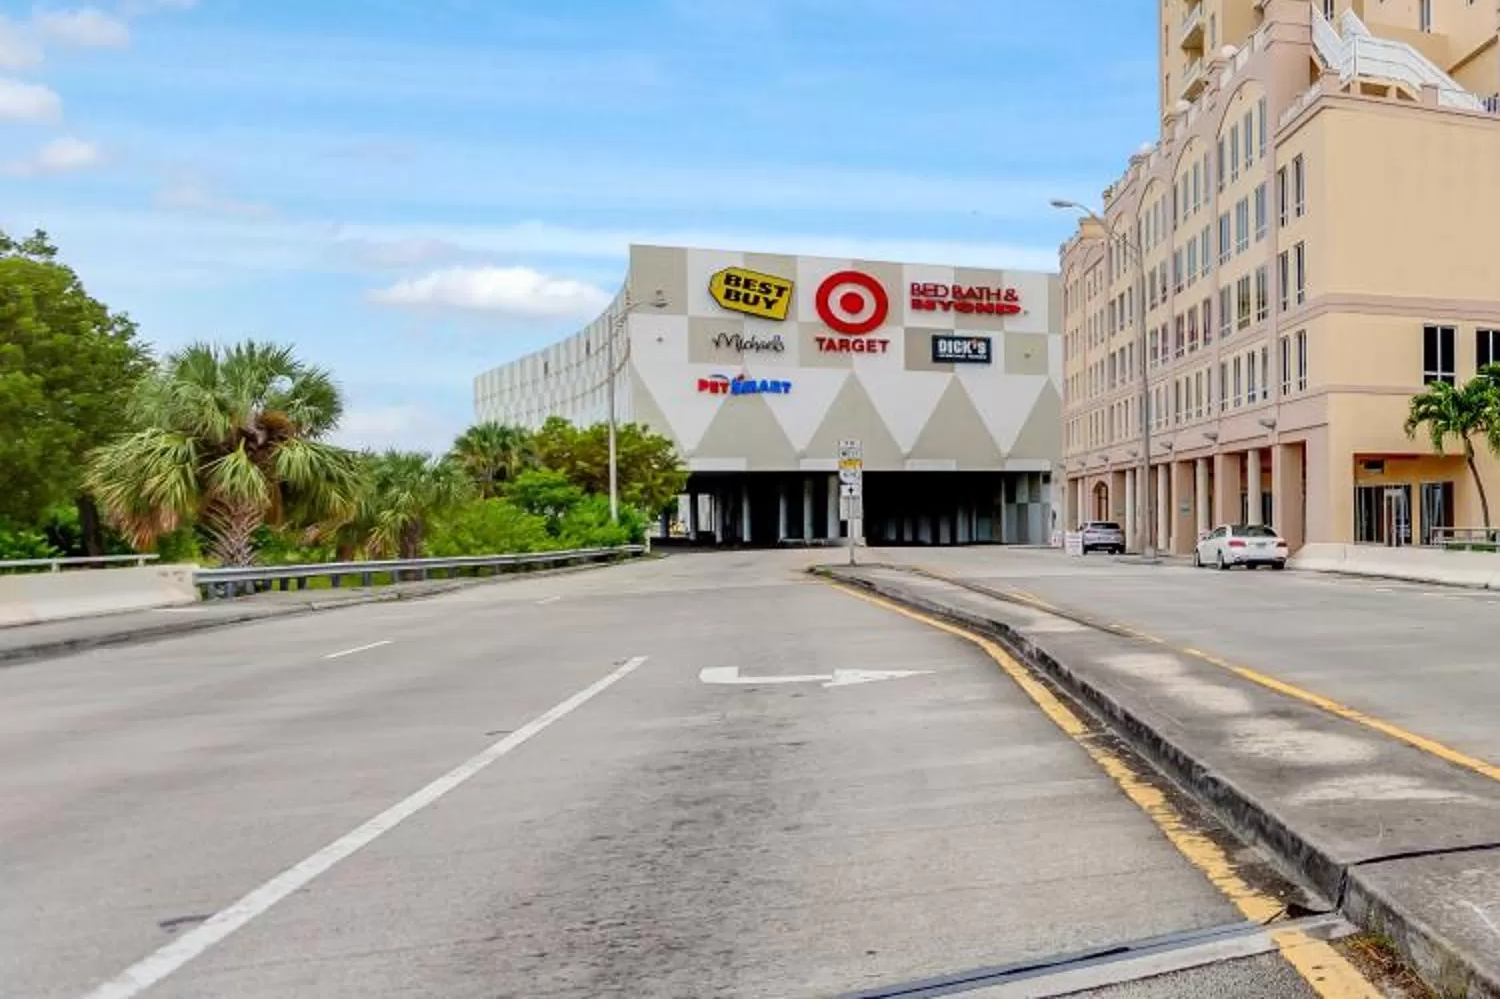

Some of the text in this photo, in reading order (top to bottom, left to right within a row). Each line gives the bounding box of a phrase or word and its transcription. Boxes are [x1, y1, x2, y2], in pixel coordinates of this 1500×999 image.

[723, 272, 789, 298] BEST
[910, 282, 1019, 302] BED BATH &
[722, 288, 779, 310] BUY
[910, 298, 1022, 315] BEYOND
[815, 336, 890, 354] TARGET
[937, 338, 987, 354] DICK'S
